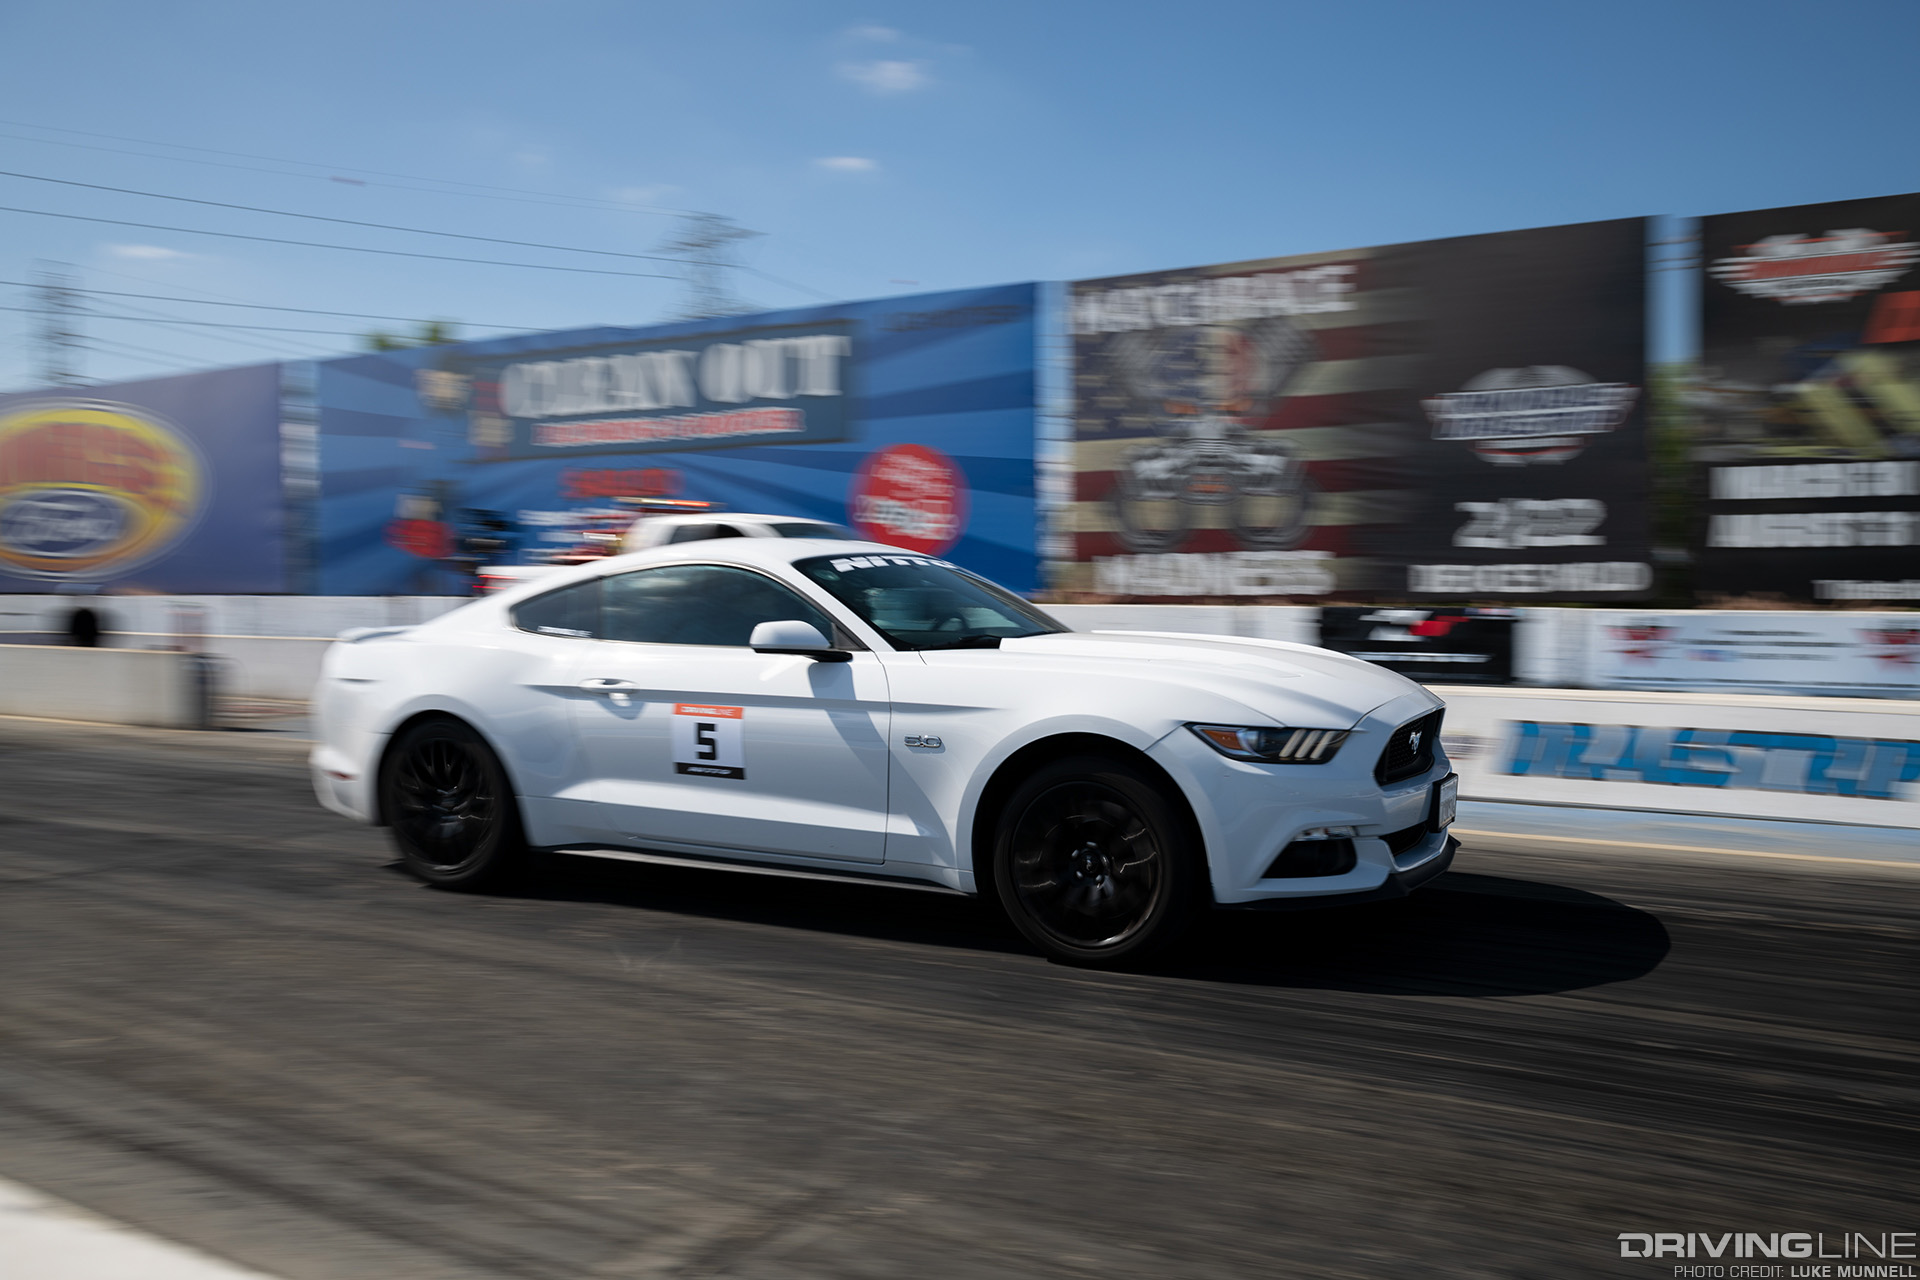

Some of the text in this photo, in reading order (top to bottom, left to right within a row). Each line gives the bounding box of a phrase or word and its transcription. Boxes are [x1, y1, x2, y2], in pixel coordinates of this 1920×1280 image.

[701, 334, 853, 404] OUT
[695, 722, 718, 761] 5
[903, 734, 943, 748] 5.0
